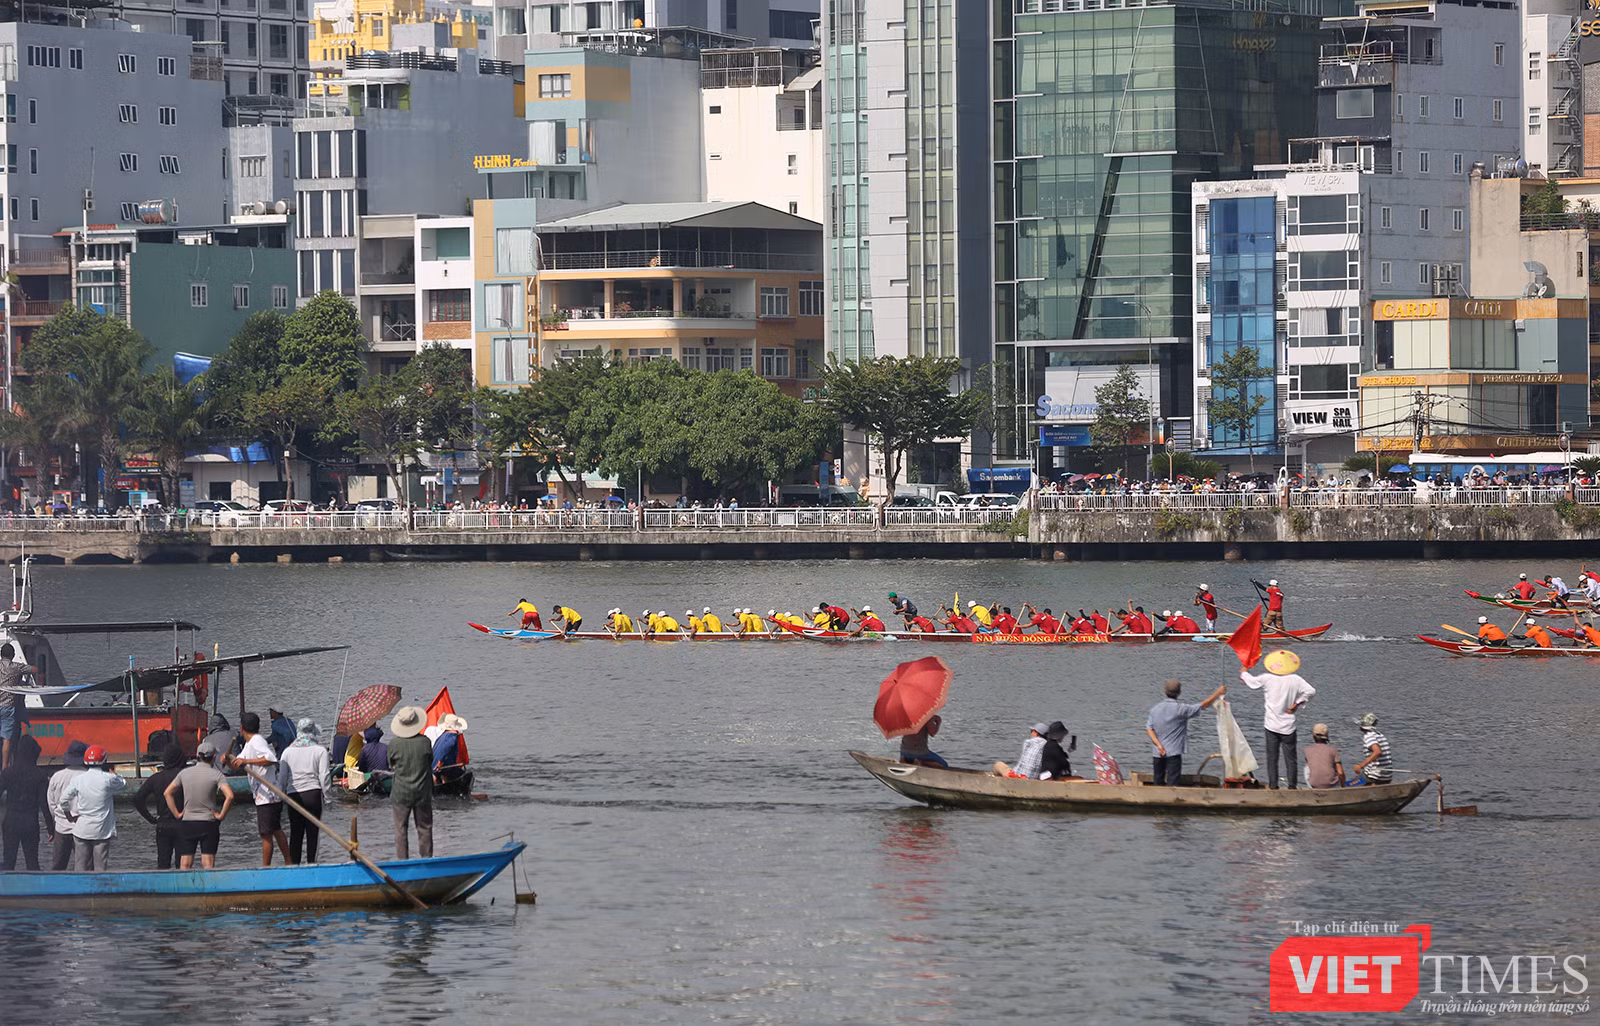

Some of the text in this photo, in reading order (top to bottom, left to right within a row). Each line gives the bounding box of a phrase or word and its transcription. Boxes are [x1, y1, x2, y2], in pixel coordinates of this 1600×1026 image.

[1382, 302, 1438, 318] CARDI
[1333, 407, 1351, 416] SPA
[1292, 412, 1327, 425] VIEW
[1332, 418, 1352, 428] NAIL
